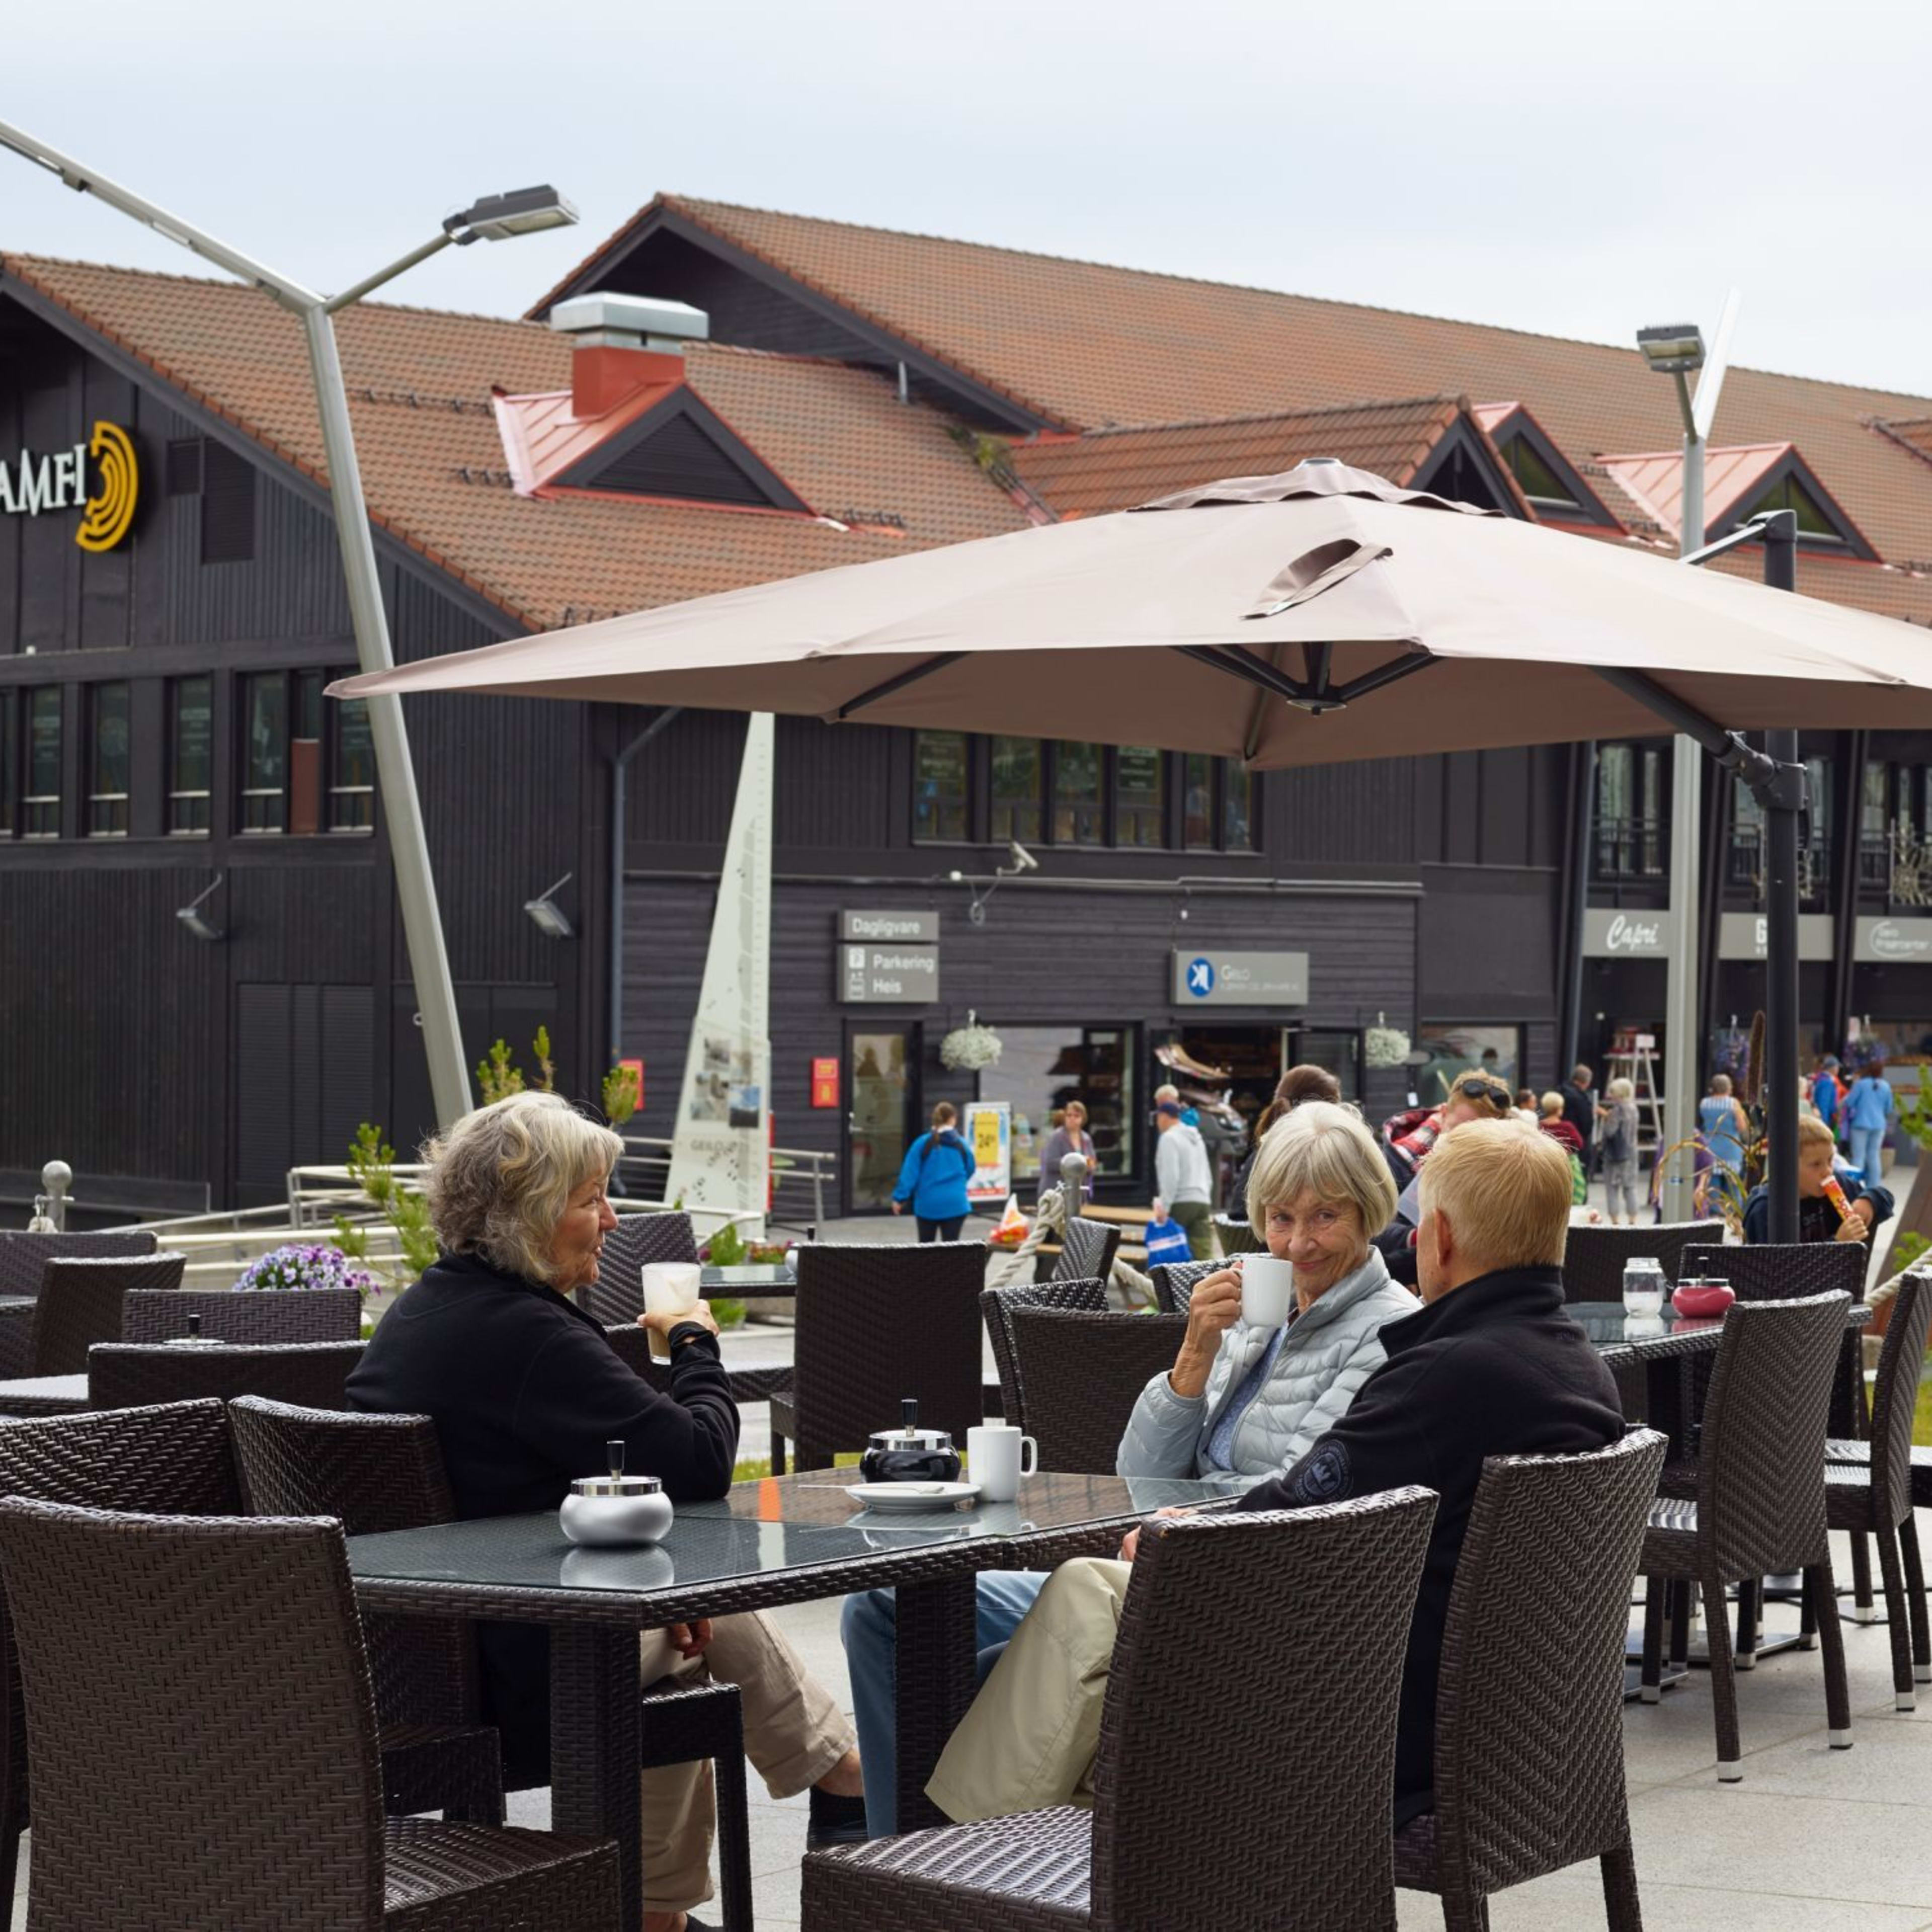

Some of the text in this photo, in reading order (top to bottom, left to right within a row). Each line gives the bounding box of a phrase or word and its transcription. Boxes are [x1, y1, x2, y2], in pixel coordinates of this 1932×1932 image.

[852, 917, 920, 937] Dagligvare
[1606, 915, 1659, 951] Capri
[873, 954, 934, 973] Parkering
[873, 978, 902, 994] Heis
